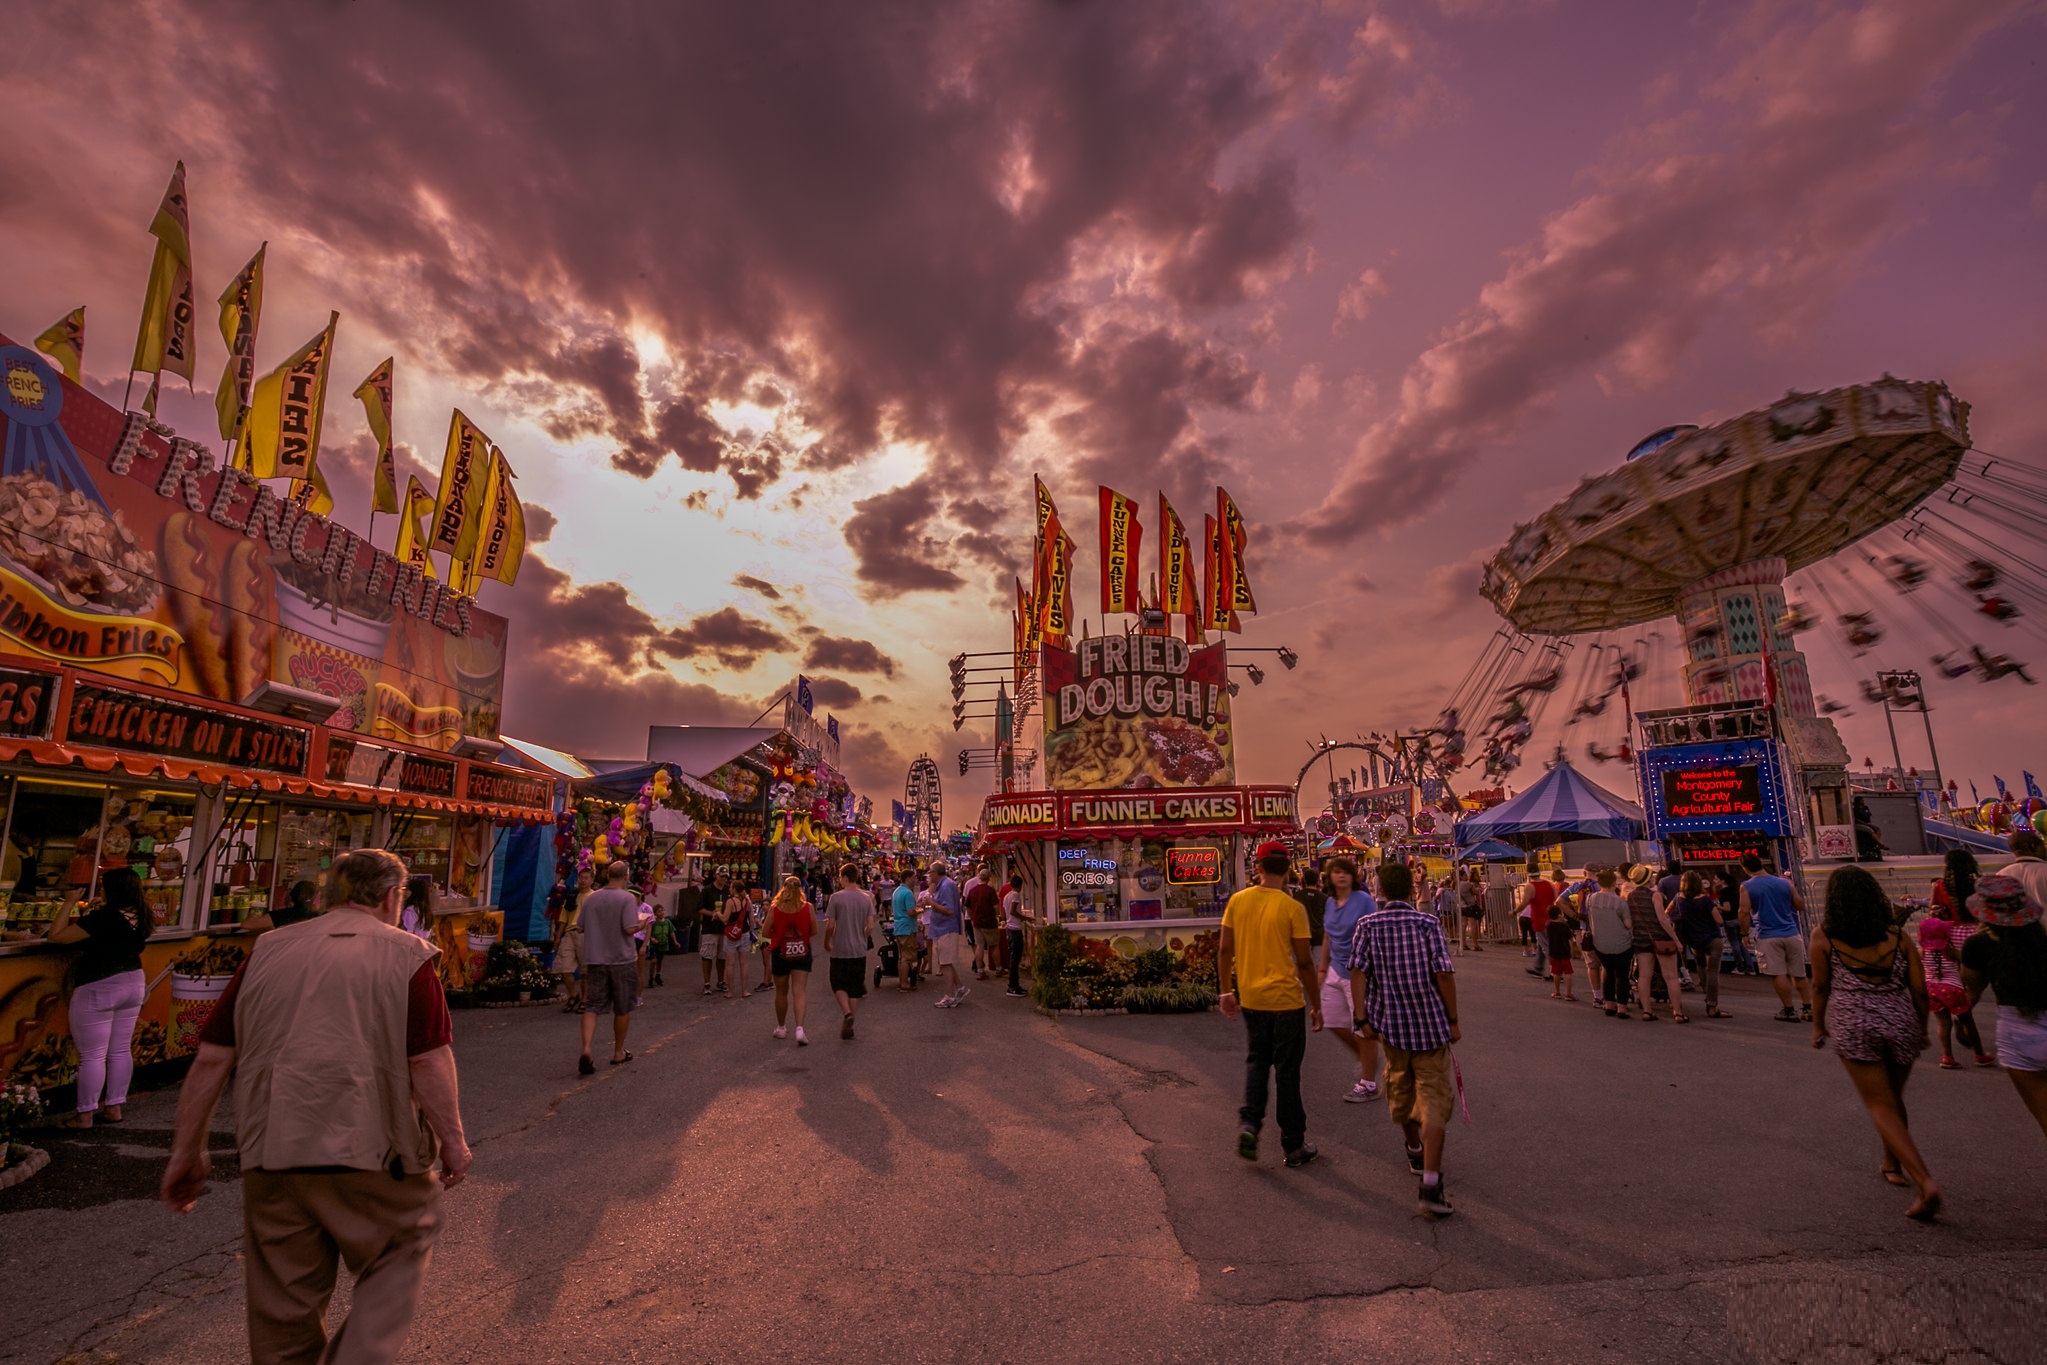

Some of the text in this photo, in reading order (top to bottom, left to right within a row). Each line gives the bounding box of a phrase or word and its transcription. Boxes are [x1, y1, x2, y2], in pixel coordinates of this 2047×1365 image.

[5, 357, 36, 373] BEST
[9, 395, 45, 411] FRIES
[438, 424, 473, 545] LEMONADE
[107, 410, 361, 583] FRENCH
[366, 549, 478, 637] FRIES
[1109, 501, 1127, 604] FUNNEL CAKES
[0, 581, 175, 656] ibbon Fries
[1080, 634, 1190, 678] FRIED
[289, 652, 367, 694] BUCKET
[1060, 674, 1219, 726] DOUGH!
[73, 695, 303, 768] CHICKEN ON A STICK
[1639, 709, 1771, 746] TICKETS
[329, 746, 378, 779] FRESH
[1679, 769, 1736, 779] Welcome to the
[468, 773, 546, 804] FRENCH FRIES
[1675, 779, 1743, 791] Montgomery
[1691, 790, 1731, 802] County
[1071, 797, 1239, 823] FUNNEL CAKES
[1671, 801, 1756, 816] Agricultural Fair
[1058, 849, 1088, 859] DEEP
[1083, 858, 1117, 870] FRIED
[1168, 850, 1217, 864] Funnel
[1683, 851, 1691, 860] 4
[1173, 865, 1215, 878] Cakes
[785, 944, 806, 955] ZOO
